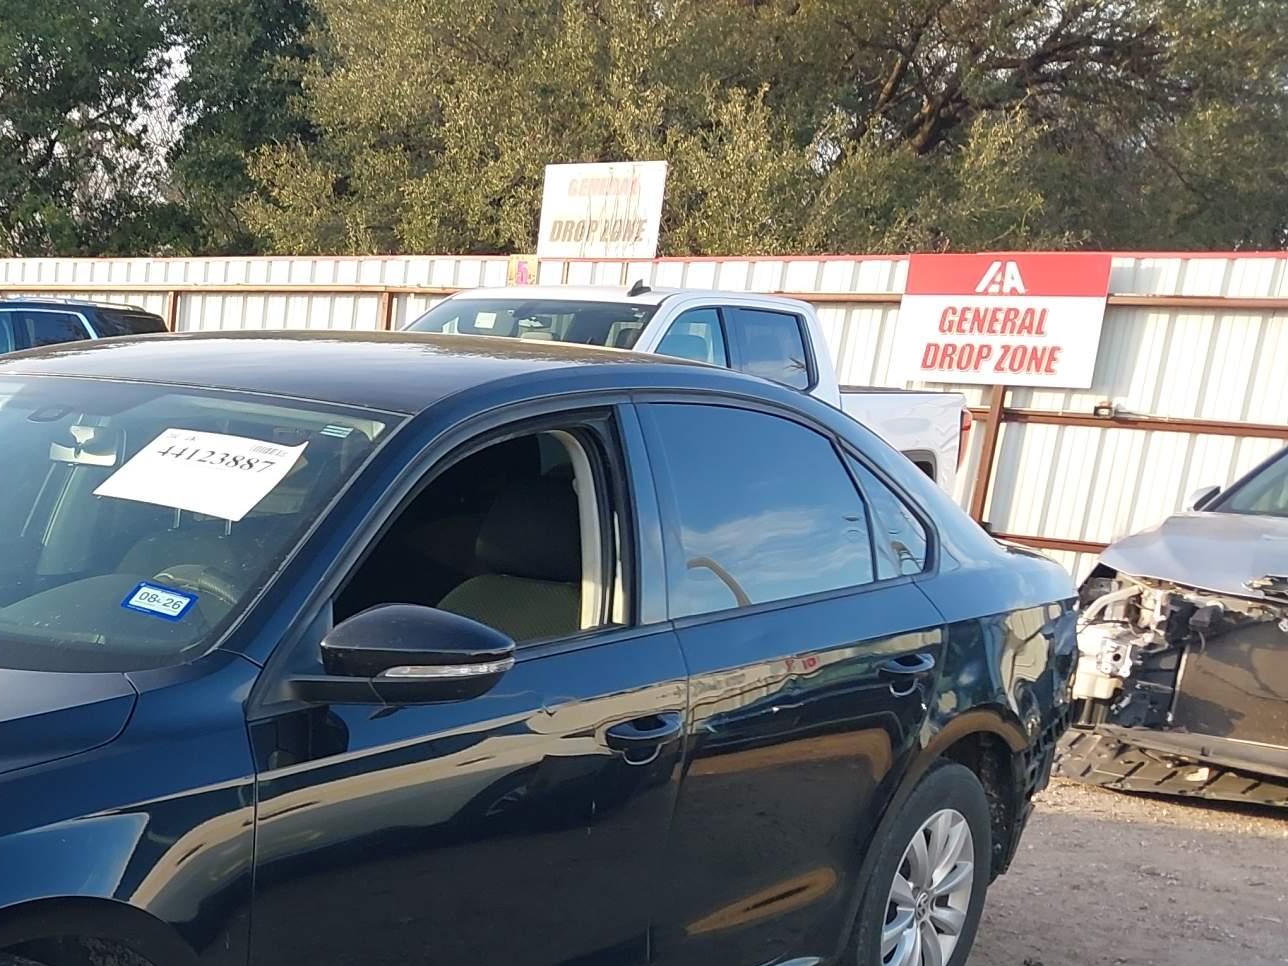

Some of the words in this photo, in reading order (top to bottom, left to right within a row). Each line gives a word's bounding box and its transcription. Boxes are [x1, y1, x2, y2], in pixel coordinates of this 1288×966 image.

[549, 218, 598, 242] DROP
[938, 306, 1049, 337] GENERAL
[920, 342, 992, 371] DROP
[993, 344, 1063, 374] ZONE
[156, 445, 276, 473] 44123887
